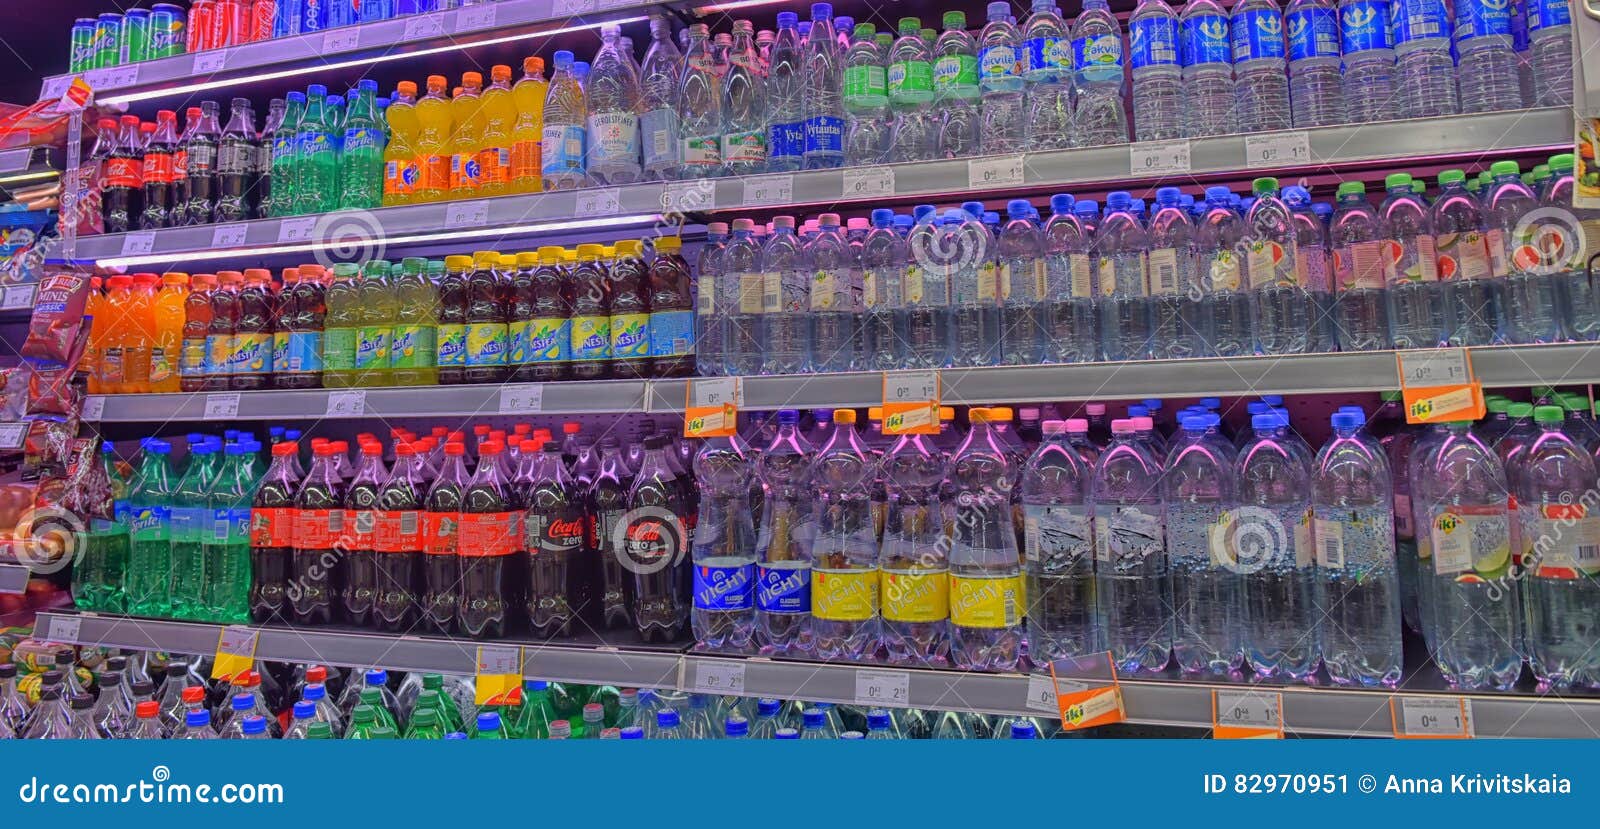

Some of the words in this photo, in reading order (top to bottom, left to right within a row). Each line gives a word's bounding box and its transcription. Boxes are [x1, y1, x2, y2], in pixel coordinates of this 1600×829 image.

[785, 129, 803, 143] Vyta
[807, 125, 841, 138] Vytautas
[39, 290, 69, 302] MINIS
[1411, 400, 1433, 417] iki
[687, 417, 704, 431] iki
[886, 414, 904, 428] iki
[131, 515, 159, 535] Sprite
[1439, 517, 1456, 530] iki
[700, 566, 747, 606] VICHY
[758, 567, 805, 607] VICHY
[818, 578, 866, 614] VICHY
[888, 576, 937, 616] VICHY
[951, 580, 999, 620] VICHY
[1065, 705, 1084, 722] iki
